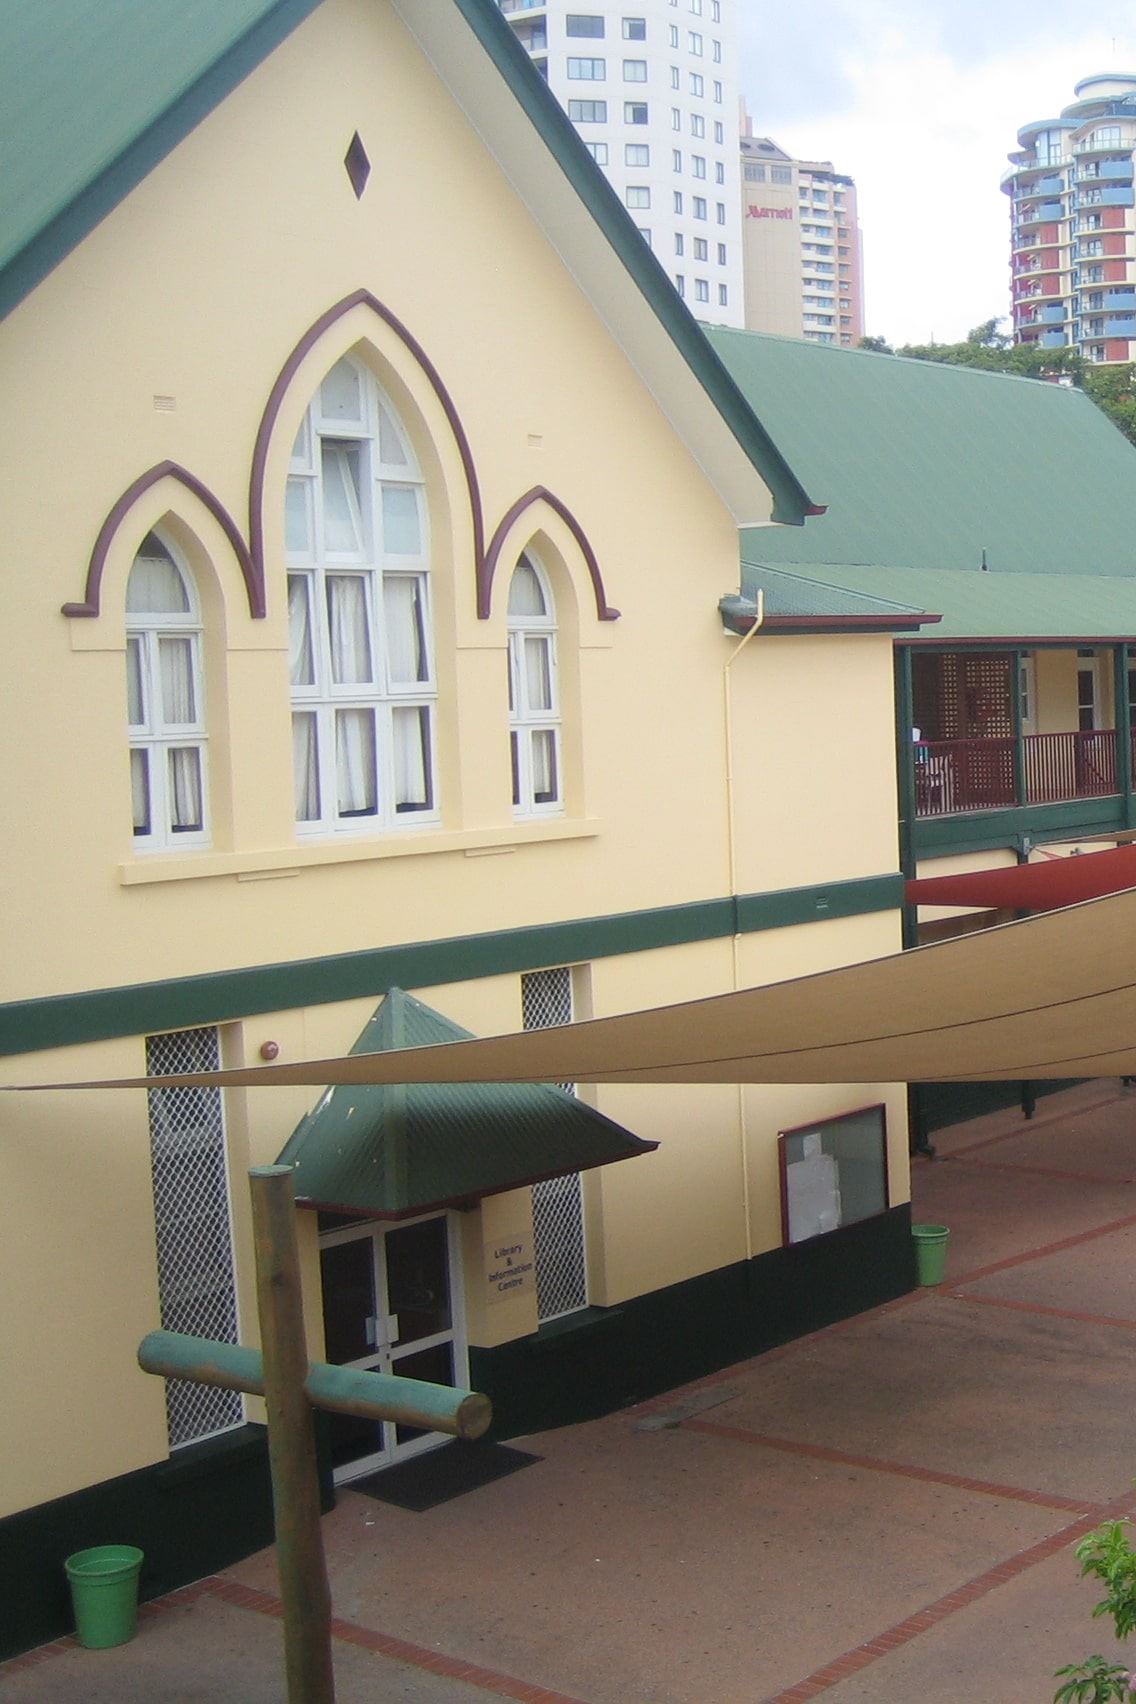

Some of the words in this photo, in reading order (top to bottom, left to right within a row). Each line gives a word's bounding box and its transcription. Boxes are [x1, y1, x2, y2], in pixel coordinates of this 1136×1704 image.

[494, 1244, 523, 1259] Library
[488, 1263, 533, 1282] Information
[498, 1278, 523, 1291] Centre
